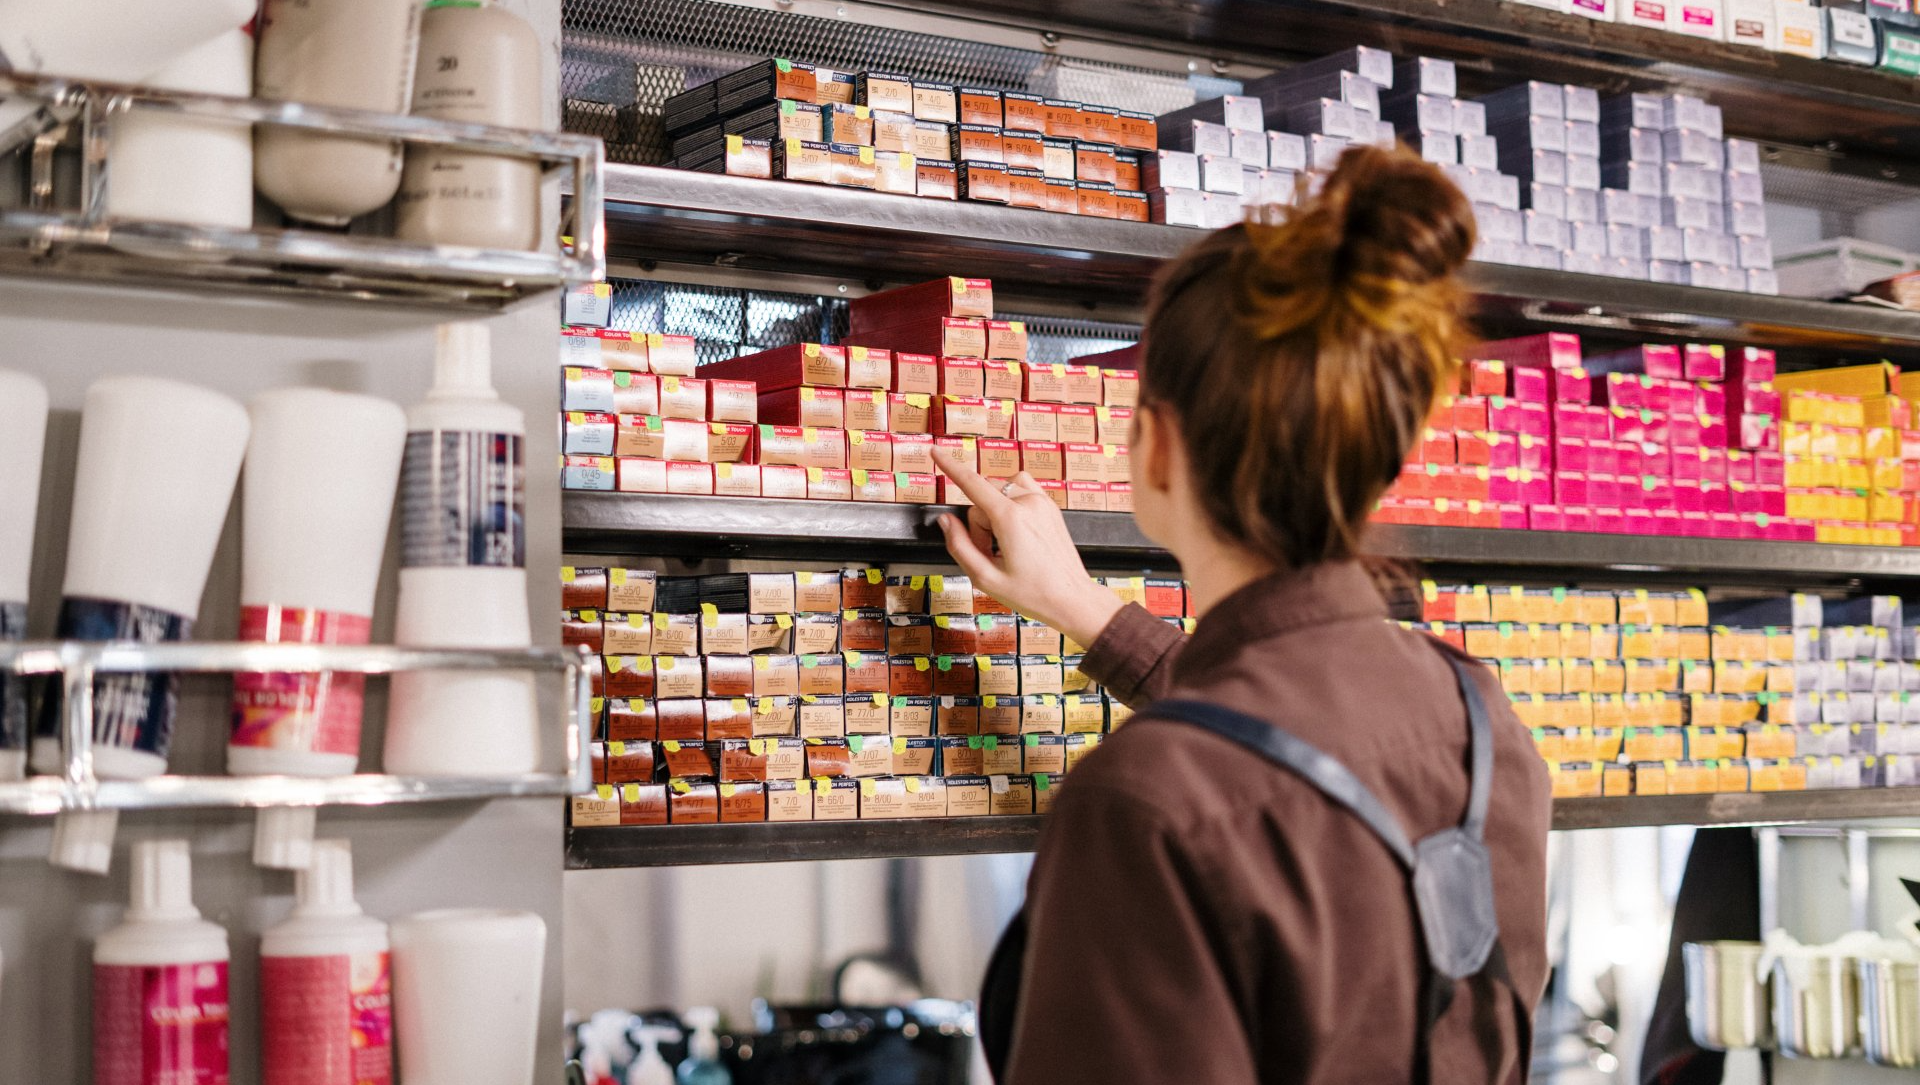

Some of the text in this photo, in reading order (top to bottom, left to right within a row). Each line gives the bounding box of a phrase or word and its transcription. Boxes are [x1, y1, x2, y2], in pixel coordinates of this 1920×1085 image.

[616, 341, 630, 351] 2/0
[720, 436, 737, 446] 5/03
[581, 469, 601, 479] 0/45
[623, 586, 641, 595] 55/0
[666, 629, 683, 640] 6/00
[810, 628, 826, 638] 7/00
[856, 708, 875, 717] 77/0
[827, 795, 844, 805] 66/0
[961, 790, 977, 800] 8/07
[786, 796, 798, 806] 7/0
